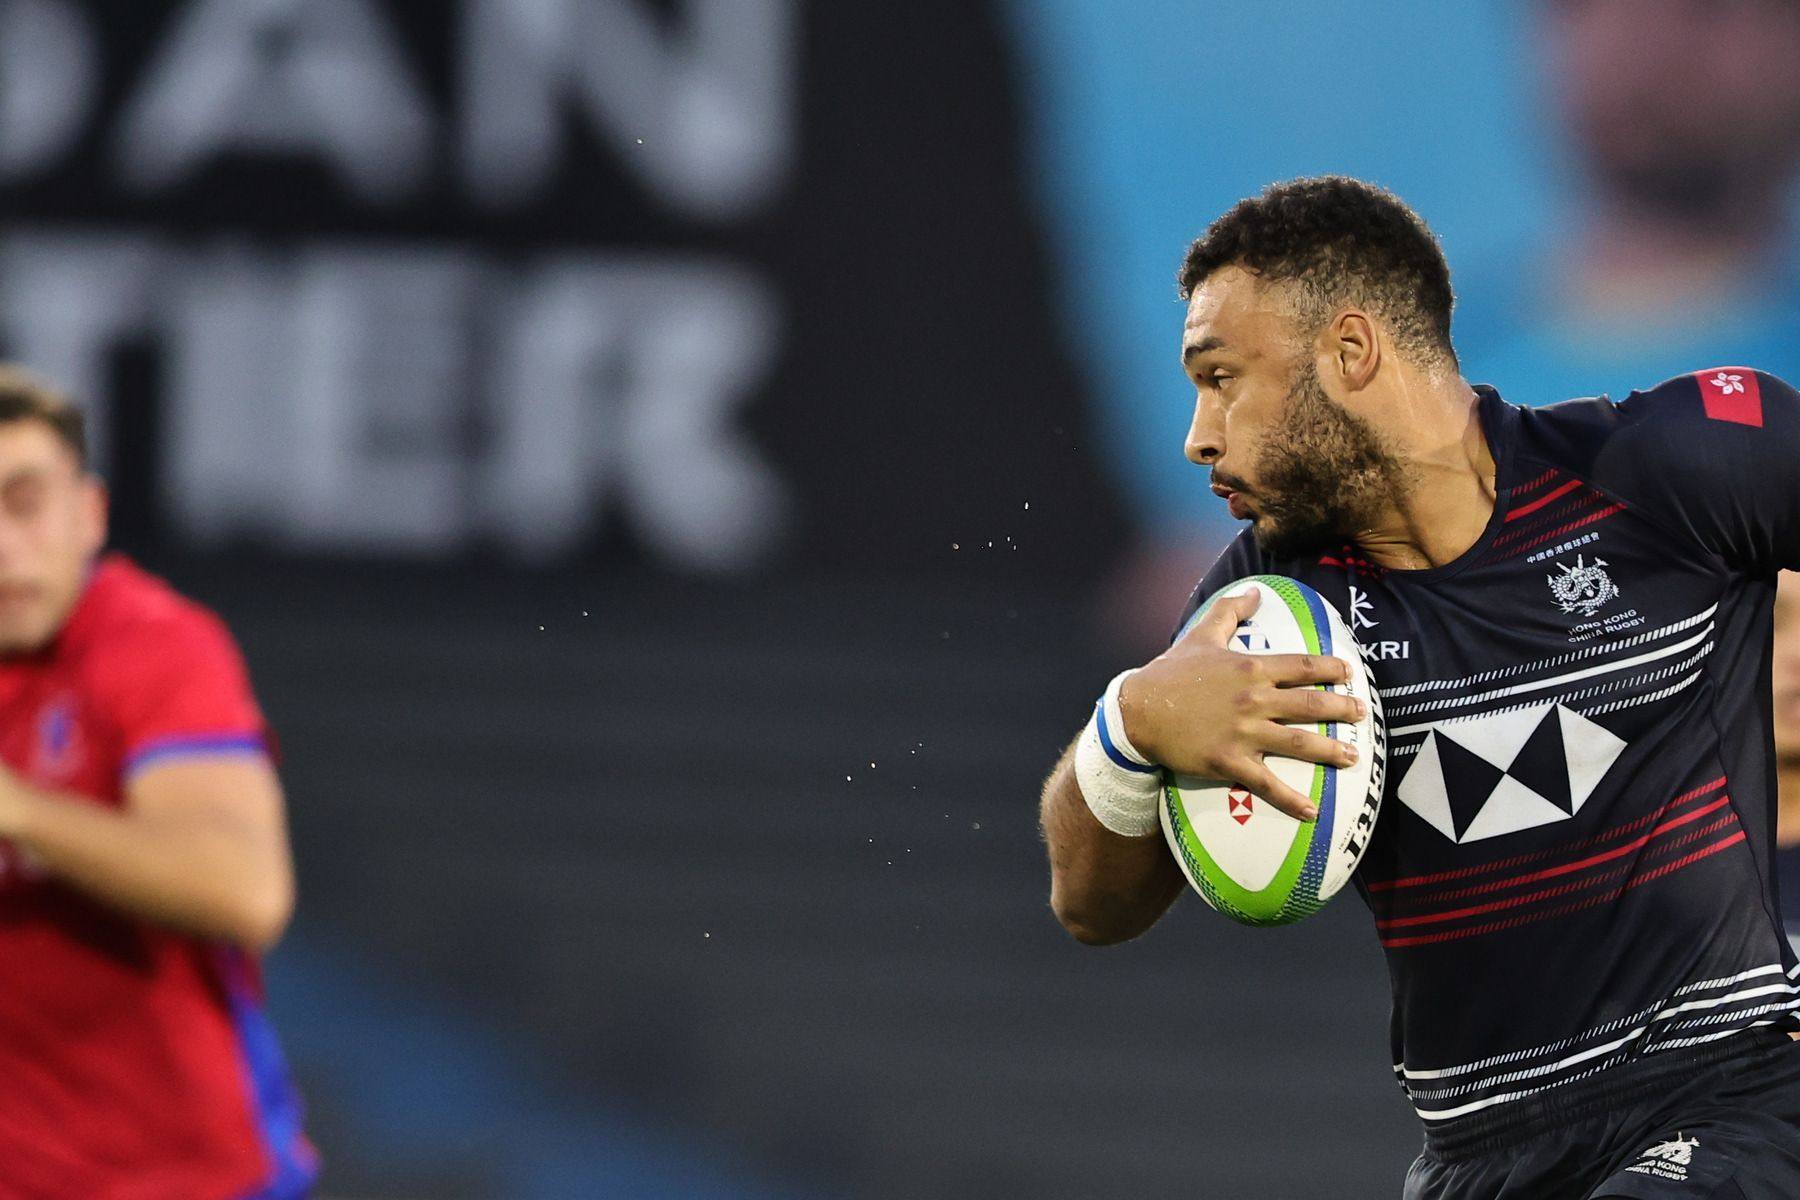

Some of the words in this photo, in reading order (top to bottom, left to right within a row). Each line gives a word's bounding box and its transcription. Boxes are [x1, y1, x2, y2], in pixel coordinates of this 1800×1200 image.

[1603, 609, 1637, 626] KONG
[1568, 629, 1604, 643] CHINA
[1605, 616, 1646, 634] RUGBY
[1652, 1168, 1688, 1181] RUGBY
[1657, 1161, 1687, 1174] KONG
